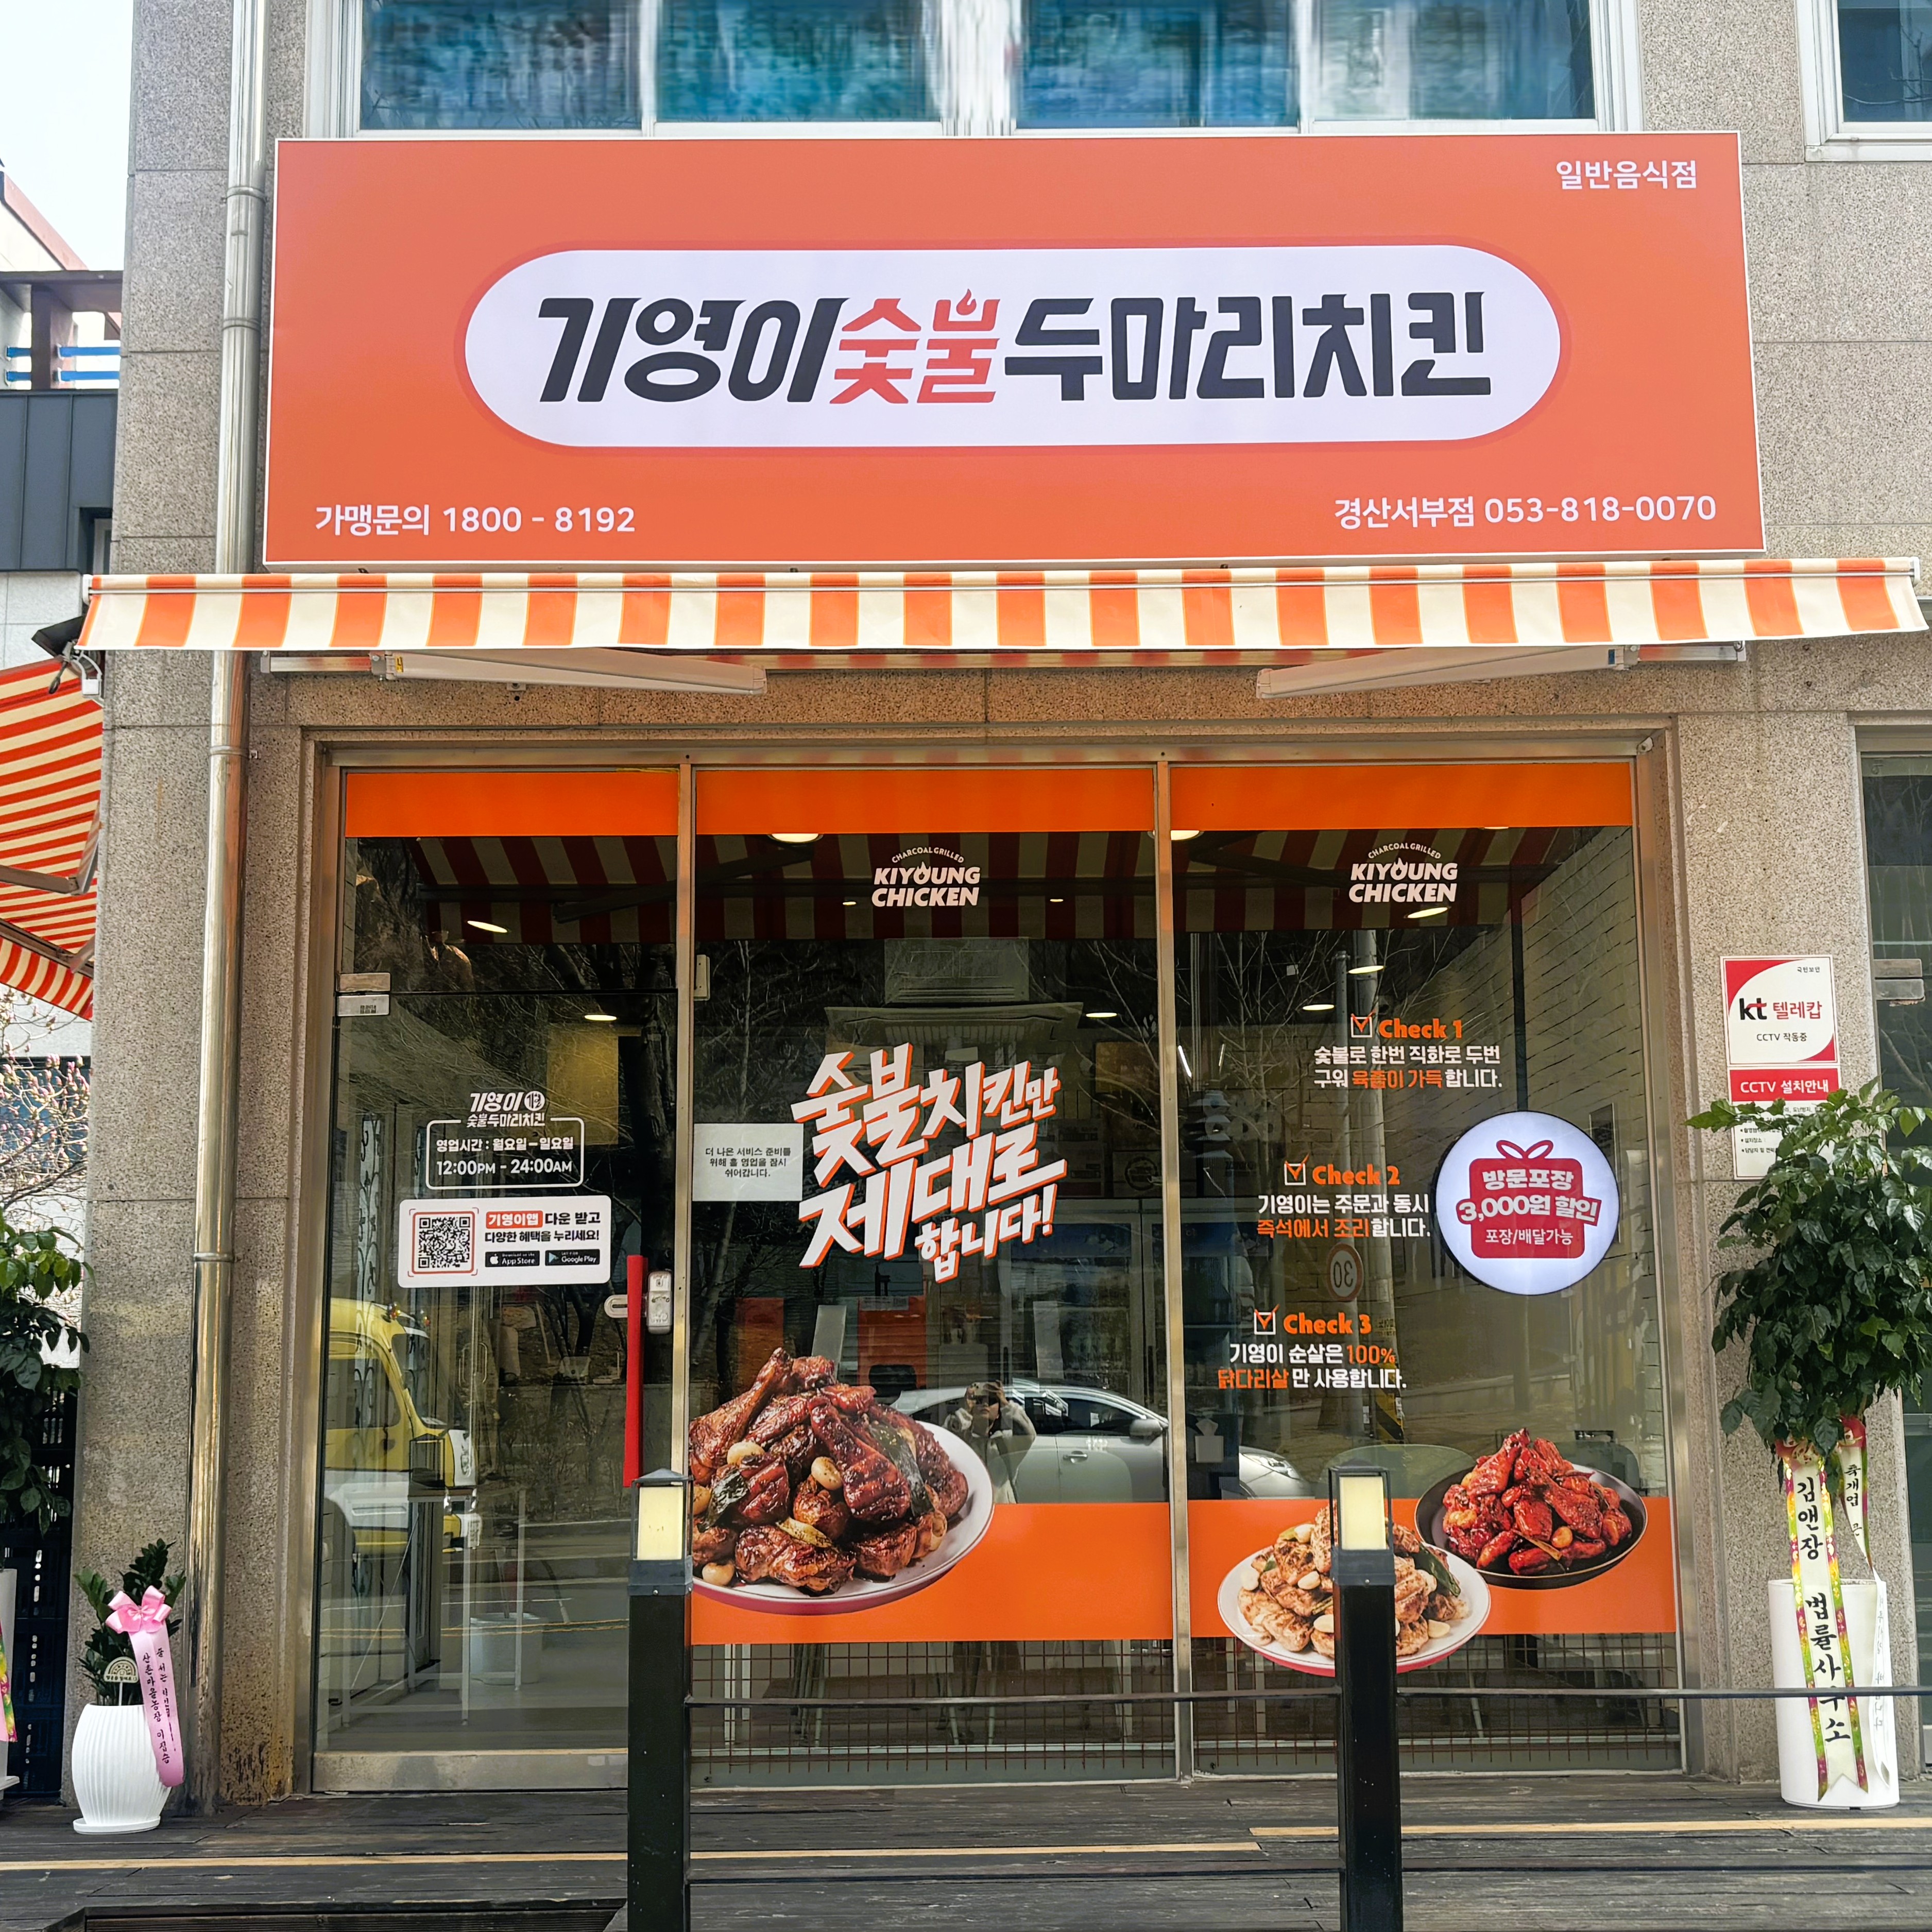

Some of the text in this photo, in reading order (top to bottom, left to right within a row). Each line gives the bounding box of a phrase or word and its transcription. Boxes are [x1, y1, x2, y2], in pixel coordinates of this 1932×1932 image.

[1556, 160, 1698, 190] 일반음식점
[315, 504, 429, 536] 가맹문의
[443, 507, 522, 532] 1800
[555, 507, 635, 532] 8192
[1334, 495, 1717, 529] 경산서부점 053-818-0070
[892, 847, 964, 863] CHARCOAL GRILLED
[1368, 843, 1441, 859] CHARCOAL GRILLED
[874, 861, 981, 885] KIYOUNG
[1350, 857, 1458, 881] KIYOUNG
[871, 887, 980, 907] CHICKEN
[1348, 883, 1457, 902] CHICKEN
[1739, 998, 1822, 1020] kt 텔레캅
[1378, 1018, 1463, 1039] Check 1
[1756, 1032, 1807, 1042] CCTV 작동중
[1313, 1046, 1501, 1065] 숯불로 한번 직화로 두번
[1314, 1069, 1348, 1088] 구워
[1352, 1069, 1405, 1089] 육즙이
[1740, 1080, 1829, 1094] CCTV 설치안내
[469, 1091, 525, 1113] 기영이
[466, 1113, 545, 1128] 숯불두마리치킨
[791, 1042, 1061, 1187] 숯불치킨만
[436, 1138, 483, 1153] 영업시간
[705, 1148, 714, 1156] 더
[716, 1148, 734, 1156] 나은
[737, 1148, 763, 1156] 서비스
[436, 1160, 496, 1176] 12:00PM
[510, 1158, 572, 1174] 24:00AM
[710, 1158, 727, 1167] 위해
[741, 1158, 766, 1167] 영업을
[770, 1158, 787, 1167] 잠시
[725, 1168, 771, 1177] 쉬어갑니다.
[1312, 1163, 1400, 1185] Check 2
[1482, 1168, 1575, 1191] 방문포장
[798, 1122, 1068, 1269] 제대로
[1258, 1193, 1429, 1215] 기영이는 주문과 동시
[488, 1211, 601, 1227] 기영이앱 다운 받고
[1458, 1194, 1598, 1223] 3,000원 할인
[485, 1229, 600, 1243] 다양한 혜택을 누리세요!
[914, 1184, 1058, 1284] 합니다!
[1256, 1218, 1329, 1239] 즉석에서
[1485, 1228, 1574, 1246] 포장/배달가능
[502, 1257, 536, 1266] App Store
[561, 1256, 584, 1264] Google
[1283, 1312, 1354, 1335] Check
[1359, 1314, 1372, 1335] 3
[1229, 1343, 1396, 1365] 기영이 순살은 100%
[1313, 1368, 1407, 1389] 사용합니다.
[1797, 1476, 1824, 1561] 김앤장
